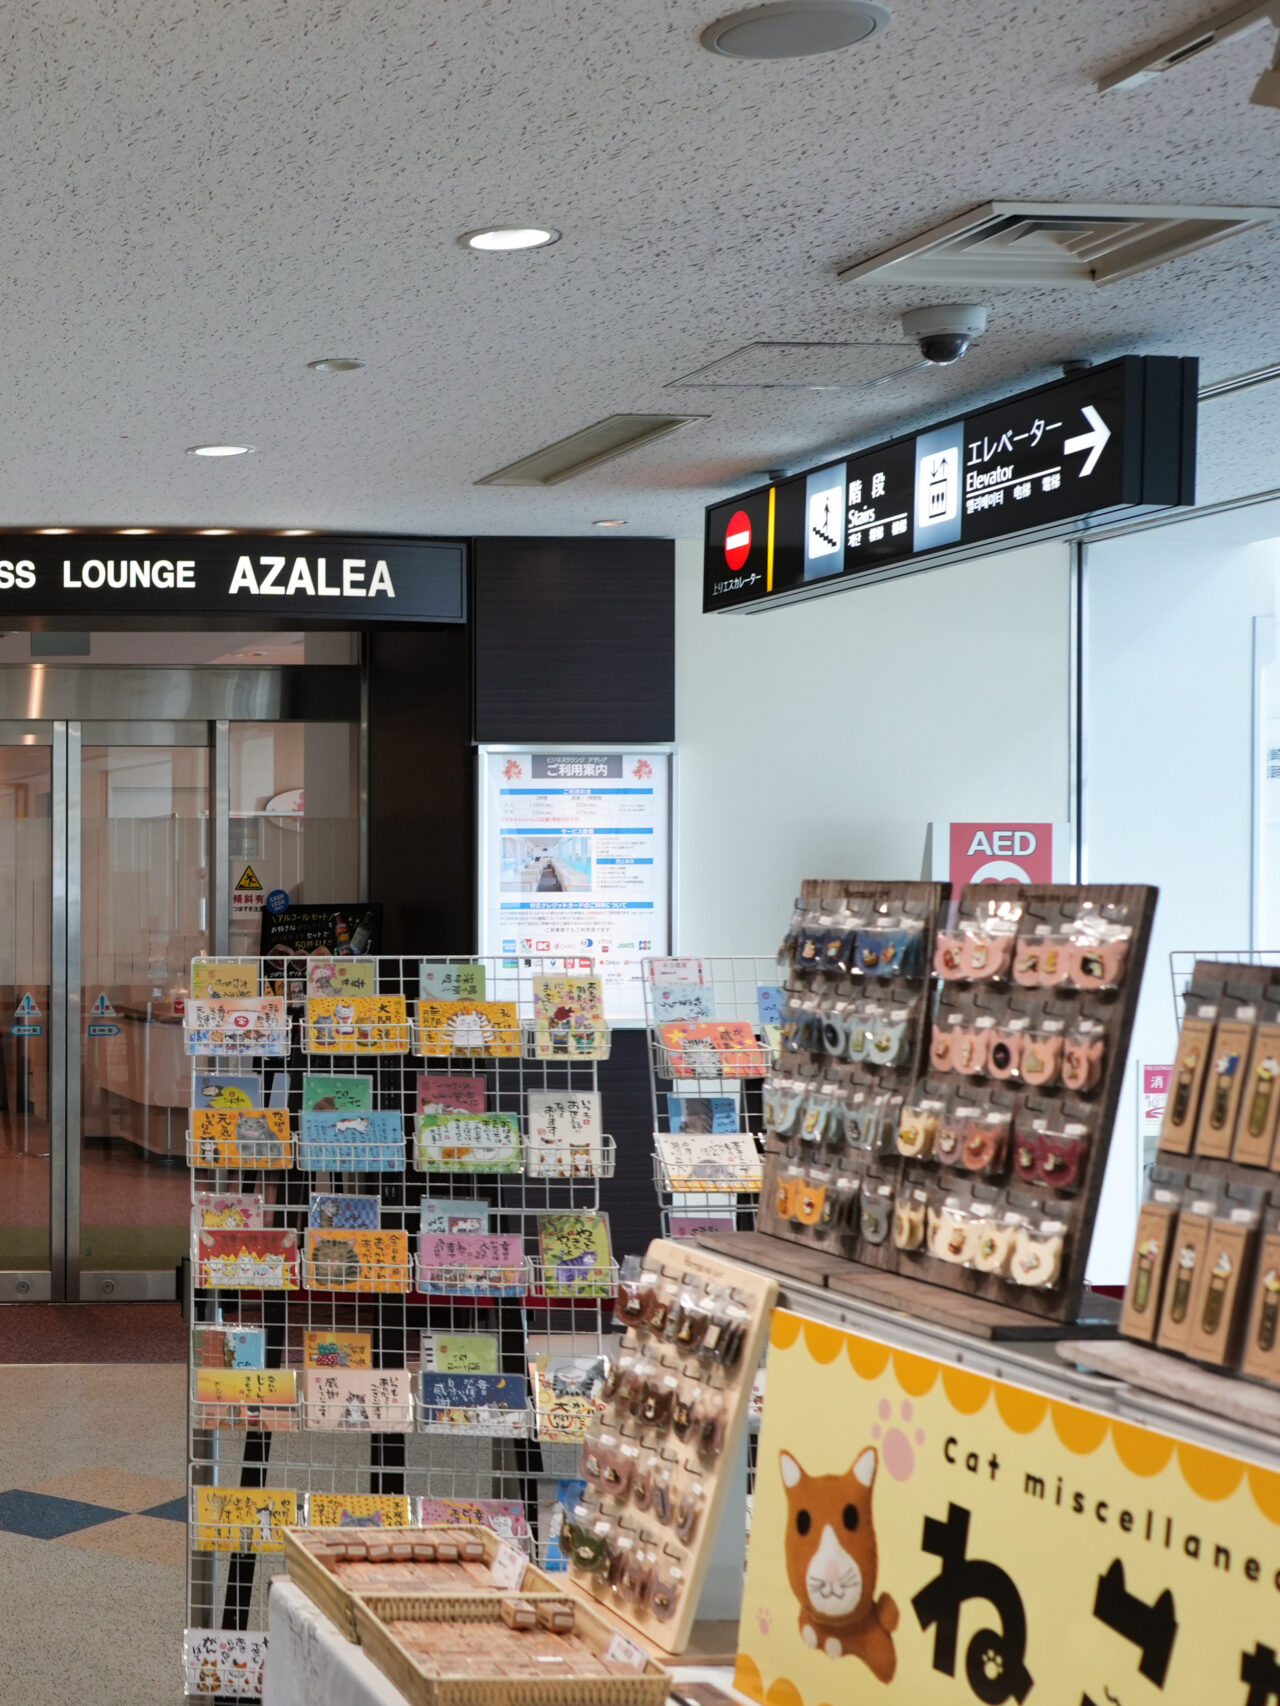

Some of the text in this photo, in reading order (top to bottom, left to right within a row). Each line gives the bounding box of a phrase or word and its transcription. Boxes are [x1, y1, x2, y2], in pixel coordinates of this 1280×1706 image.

[967, 419, 1062, 466] エレベーター
[848, 472, 886, 506] 階段
[966, 464, 1015, 492] Elevator
[848, 505, 876, 528] Stairs
[62, 559, 197, 590] LOUNGE
[228, 556, 396, 598] AZALEA
[712, 573, 762, 596] 上りエスカレーター
[546, 763, 608, 777] ご利用案内
[966, 830, 1038, 857] AED
[233, 894, 265, 905] 傾斜有
[943, 1435, 1001, 1482] Cat
